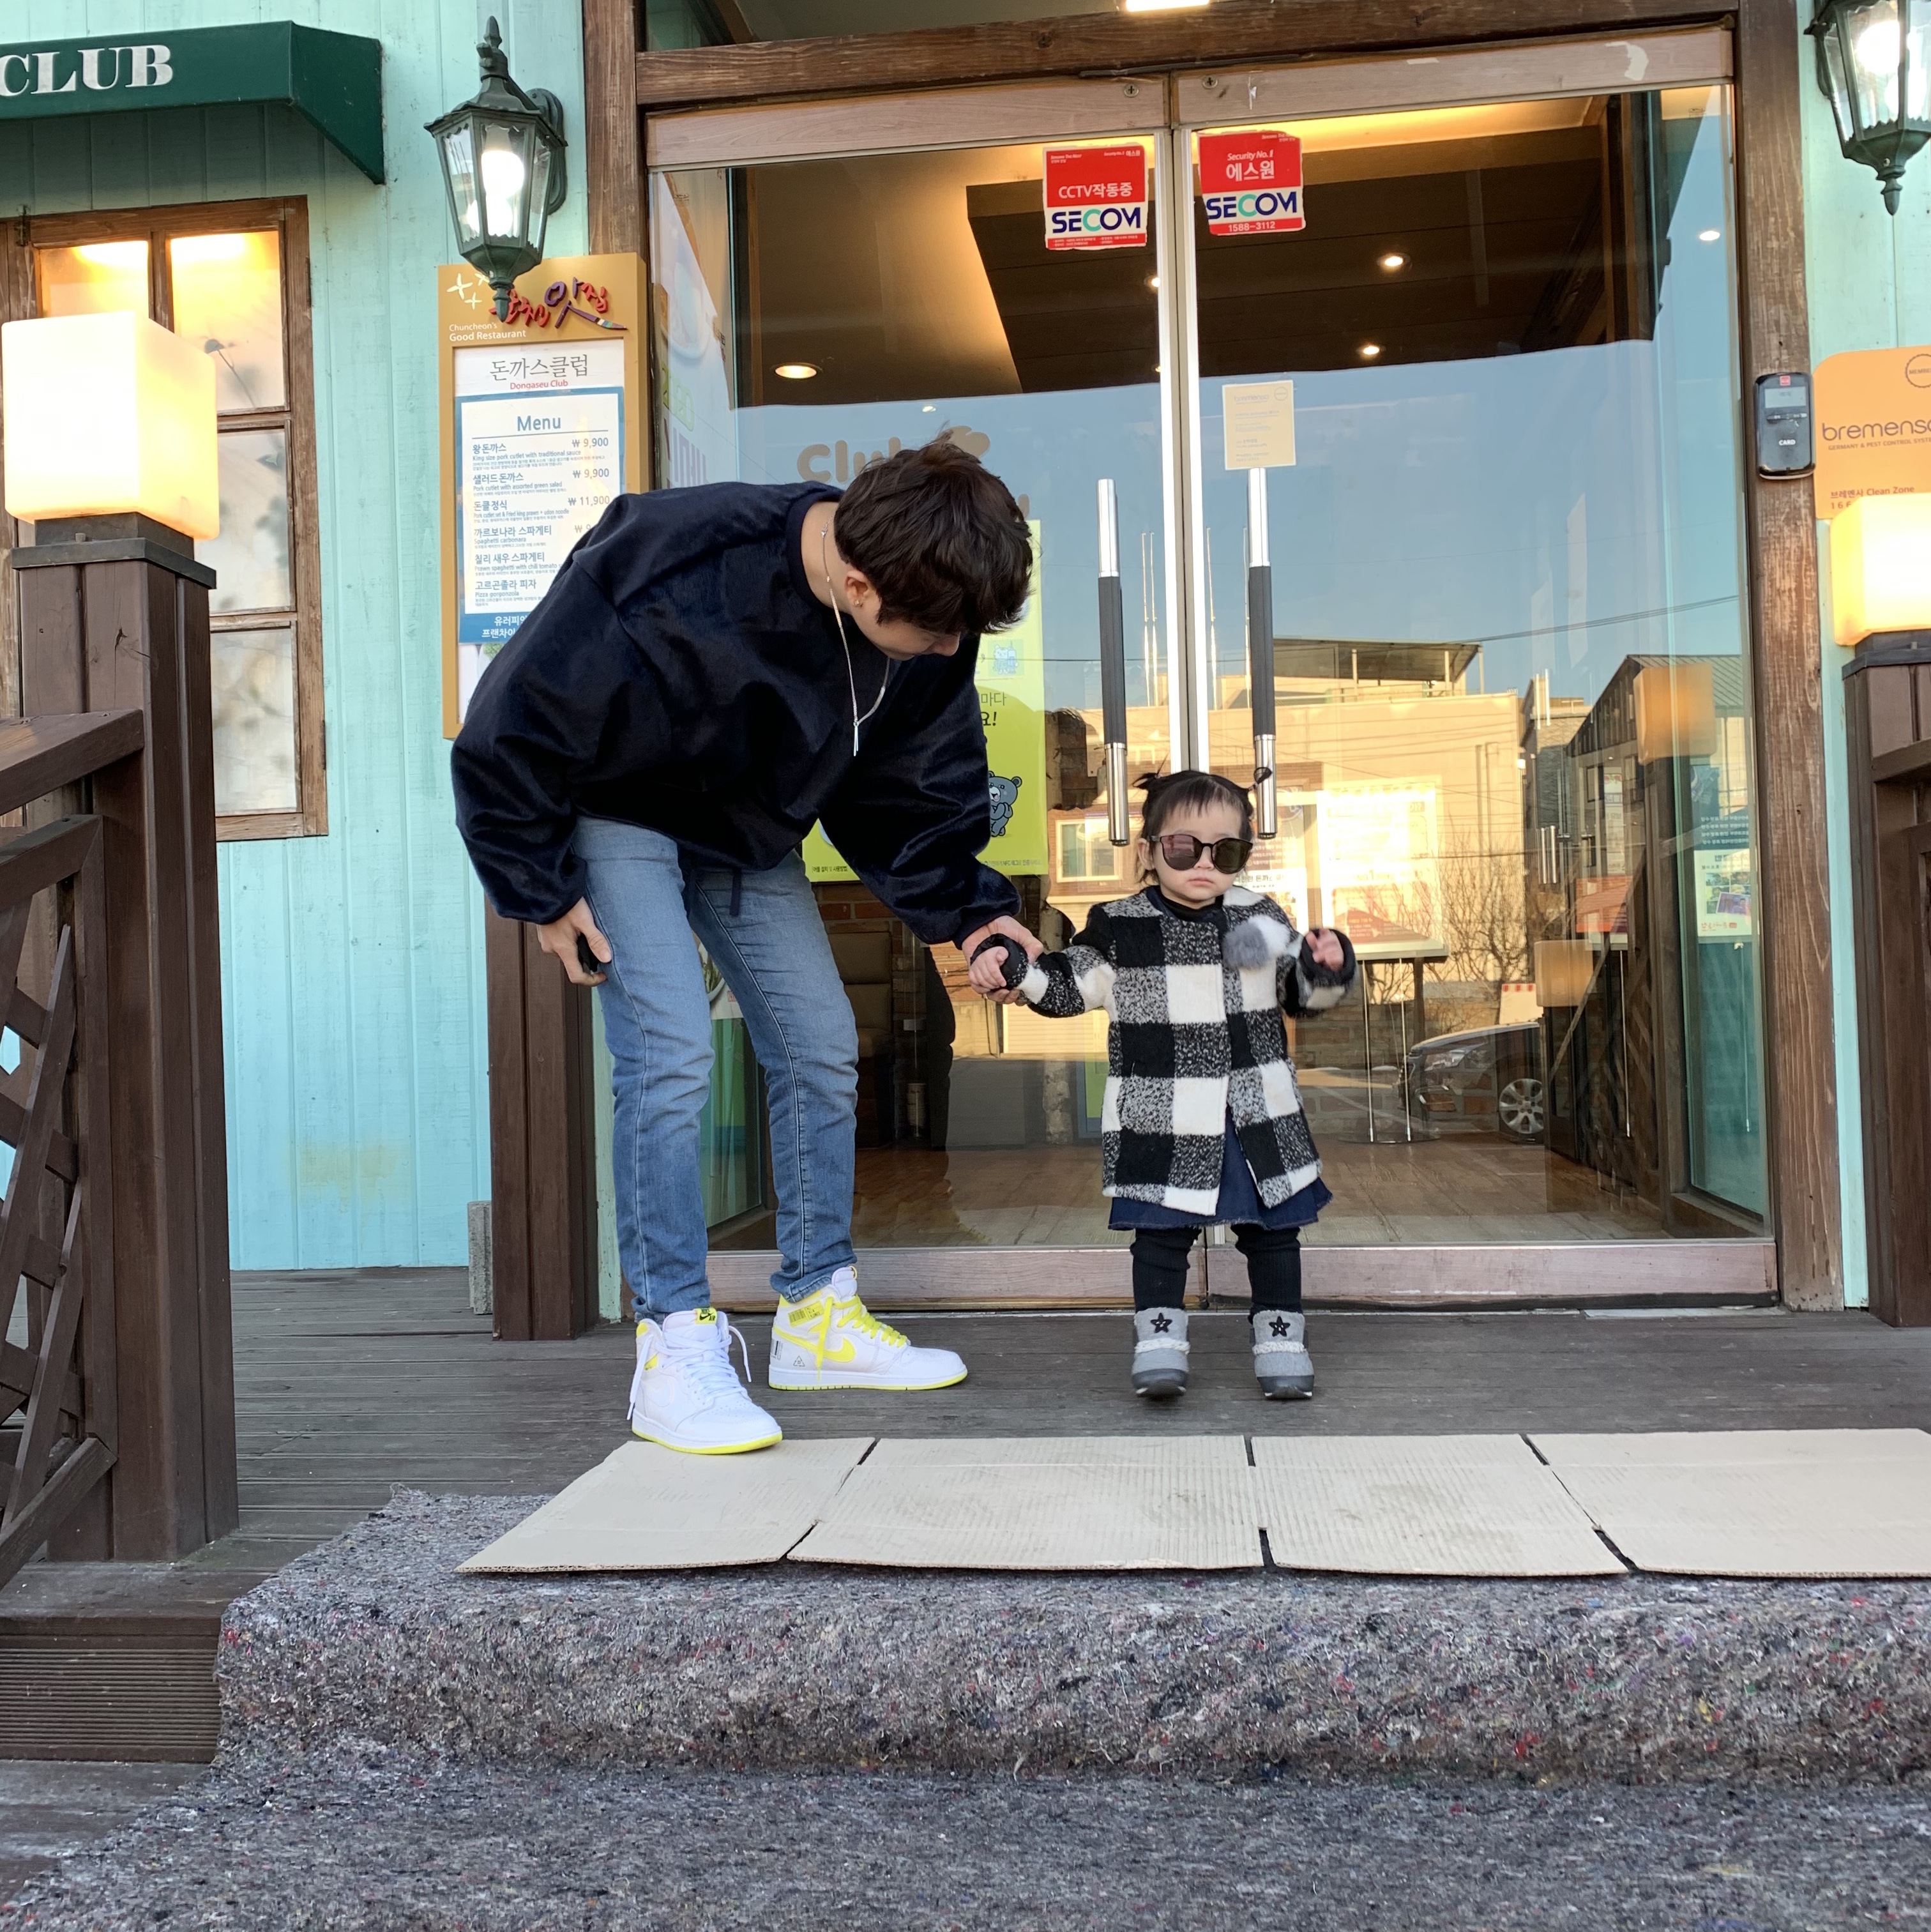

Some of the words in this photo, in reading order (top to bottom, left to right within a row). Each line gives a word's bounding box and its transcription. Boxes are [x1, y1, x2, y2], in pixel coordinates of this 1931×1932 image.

[0, 44, 174, 98] CLUB
[1227, 150, 1255, 162] Security
[1256, 149, 1274, 160] No.1
[1225, 160, 1275, 182] 에스원
[1058, 182, 1133, 200] CCTV작동중
[1206, 191, 1298, 220] SECOM
[1052, 207, 1142, 234] SECOM
[1228, 221, 1276, 232] 1588-3112
[449, 322, 497, 331] Chuncheon's
[449, 331, 474, 342] Good
[476, 330, 527, 340] Restaurant
[490, 354, 589, 381] 돈까스클럽
[1909, 367, 1931, 376] MEMBE
[550, 379, 569, 388] Club
[517, 415, 562, 432] Menu
[482, 442, 507, 453] 돈까스
[584, 437, 609, 448] 9,900
[1883, 439, 1912, 447] CONTROL
[538, 450, 565, 458] traditional
[473, 474, 498, 485] 샐러드
[499, 472, 524, 483] 돈까스
[584, 468, 610, 479] 9,900
[1867, 487, 1891, 496] Clean
[1893, 485, 1915, 494] Zone
[580, 495, 610, 506] 11,900
[474, 526, 517, 538] 까르보나라
[519, 524, 552, 536] 스파게티
[475, 553, 491, 565] 칠리
[494, 552, 510, 563] 새우
[511, 552, 545, 563] 스파게티
[475, 579, 518, 590] 고르곤졸라
[520, 579, 537, 589] 피자
[489, 590, 520, 598] gorgonzola
[978, 692, 1007, 706] 마다
